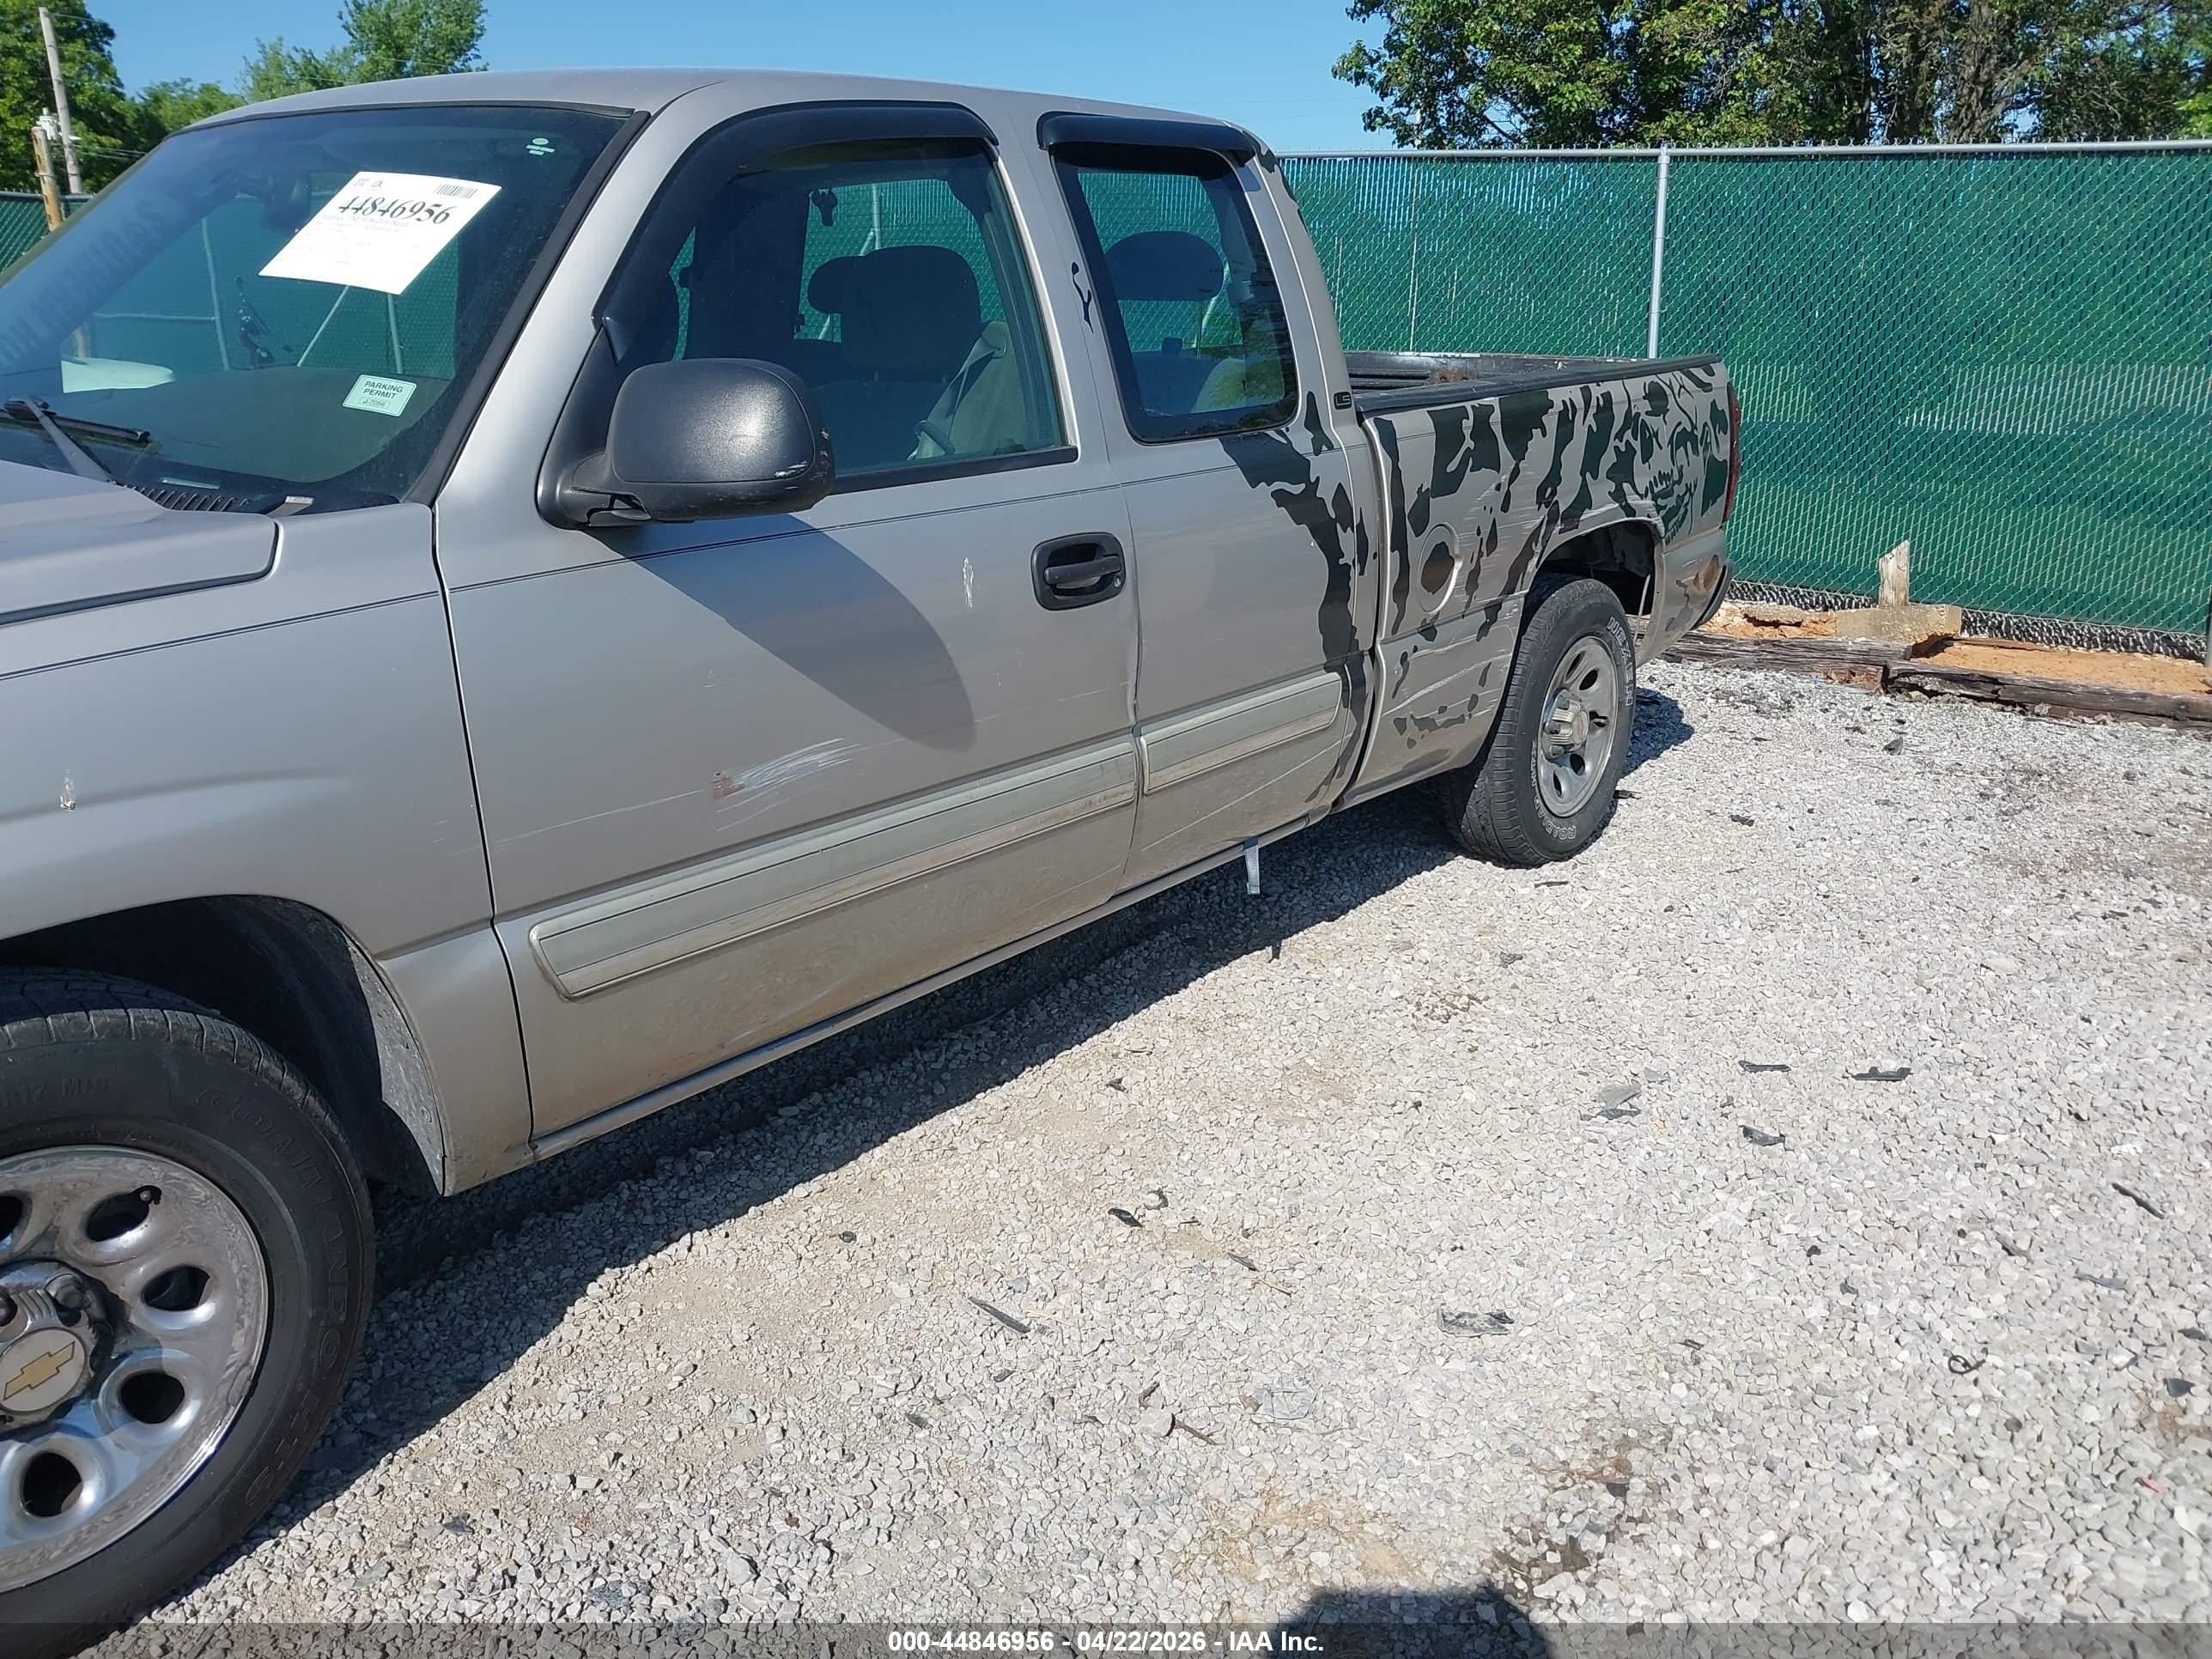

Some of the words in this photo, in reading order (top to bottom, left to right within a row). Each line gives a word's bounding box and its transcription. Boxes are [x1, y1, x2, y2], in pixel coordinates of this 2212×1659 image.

[338, 196, 459, 224] 44846956
[363, 388, 398, 399] PERMIT
[364, 380, 404, 393] PARKING
[1335, 394, 1352, 408] LS
[1607, 617, 1634, 707] NEXEN
